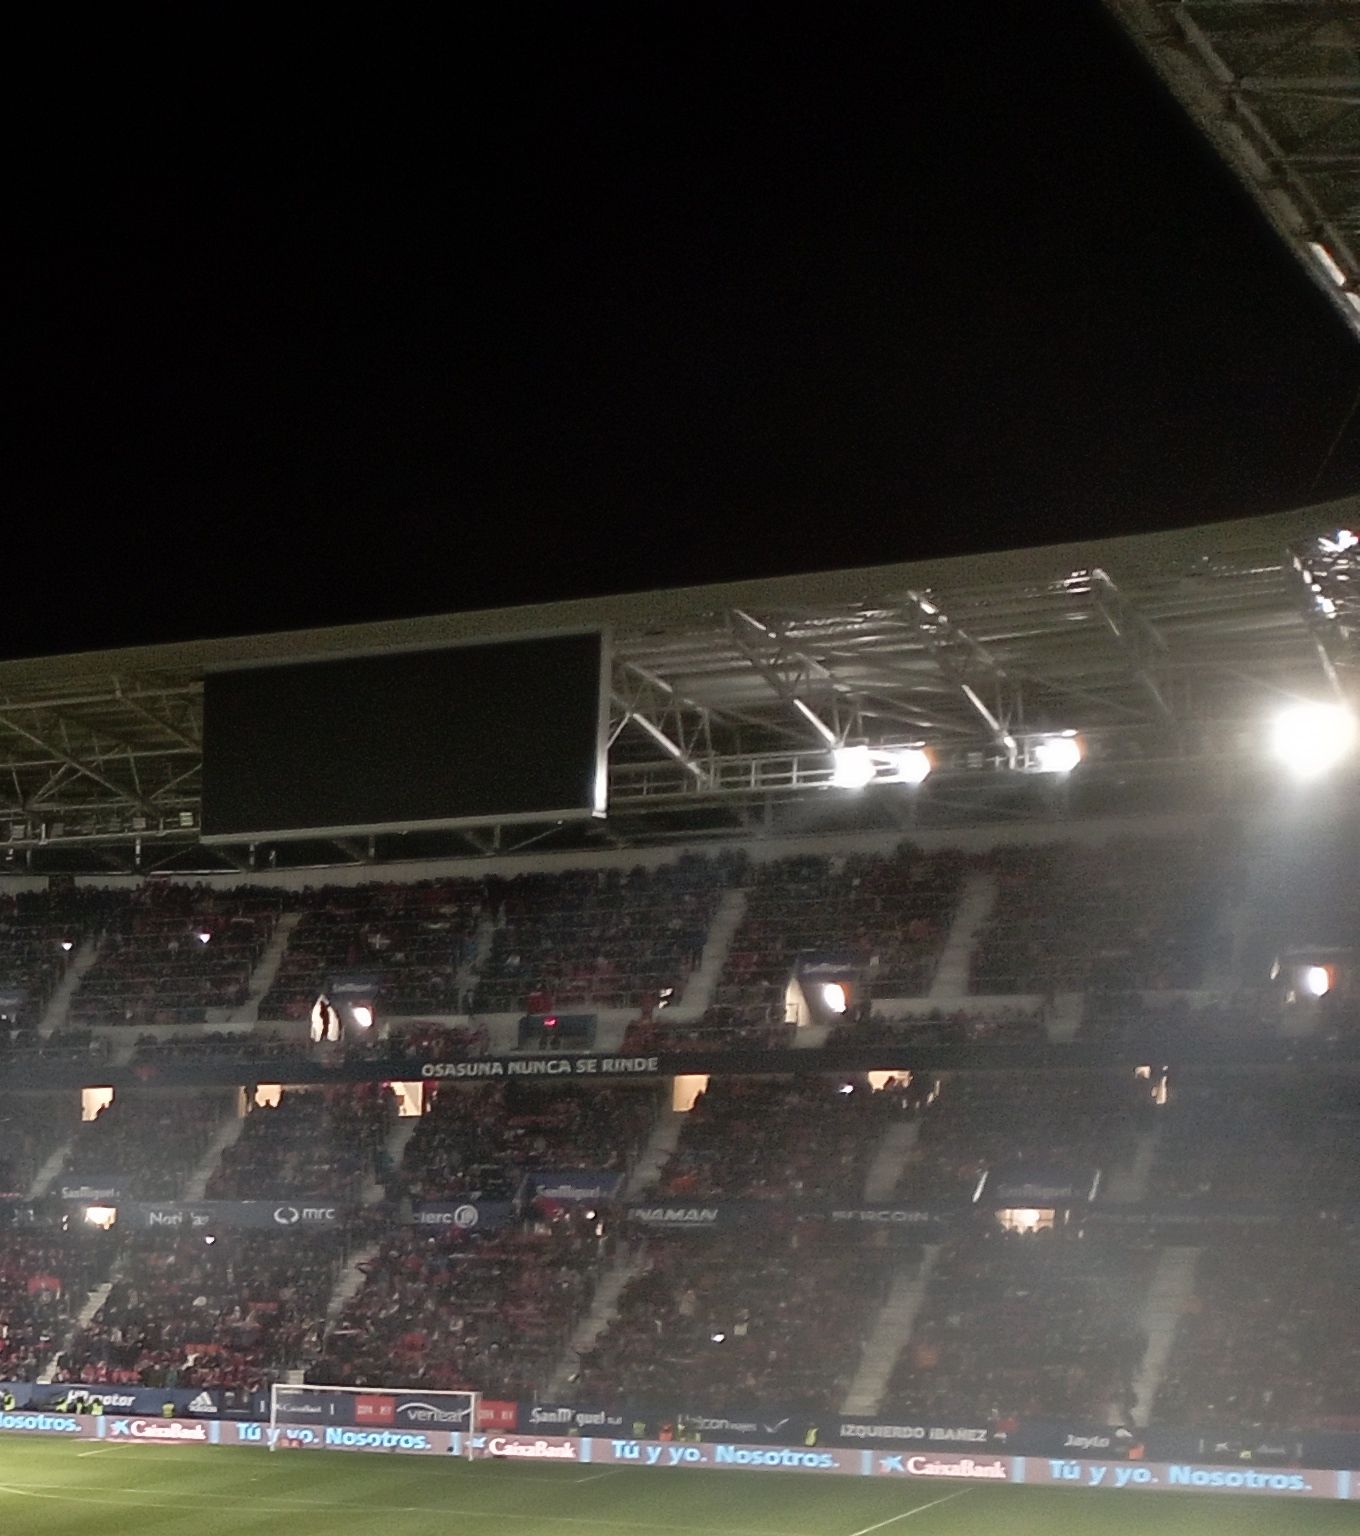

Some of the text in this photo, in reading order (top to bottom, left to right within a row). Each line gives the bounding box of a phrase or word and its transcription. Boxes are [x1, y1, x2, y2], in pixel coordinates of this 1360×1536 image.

[421, 1057, 659, 1077] OSASUNA NUNCA SE RINDE
[302, 1208, 336, 1220] mrc
[130, 1420, 207, 1440] CaixaBank
[236, 1422, 261, 1440] Tú
[286, 1428, 319, 1444] yo.
[325, 1427, 432, 1449] Nosotros.
[488, 1437, 577, 1458] CaixaBank
[611, 1440, 840, 1468] Tú y yo. Nosotros.
[907, 1456, 1007, 1479] CaixaBank
[1049, 1460, 1313, 1491] Tú y yo. Nosotros.
